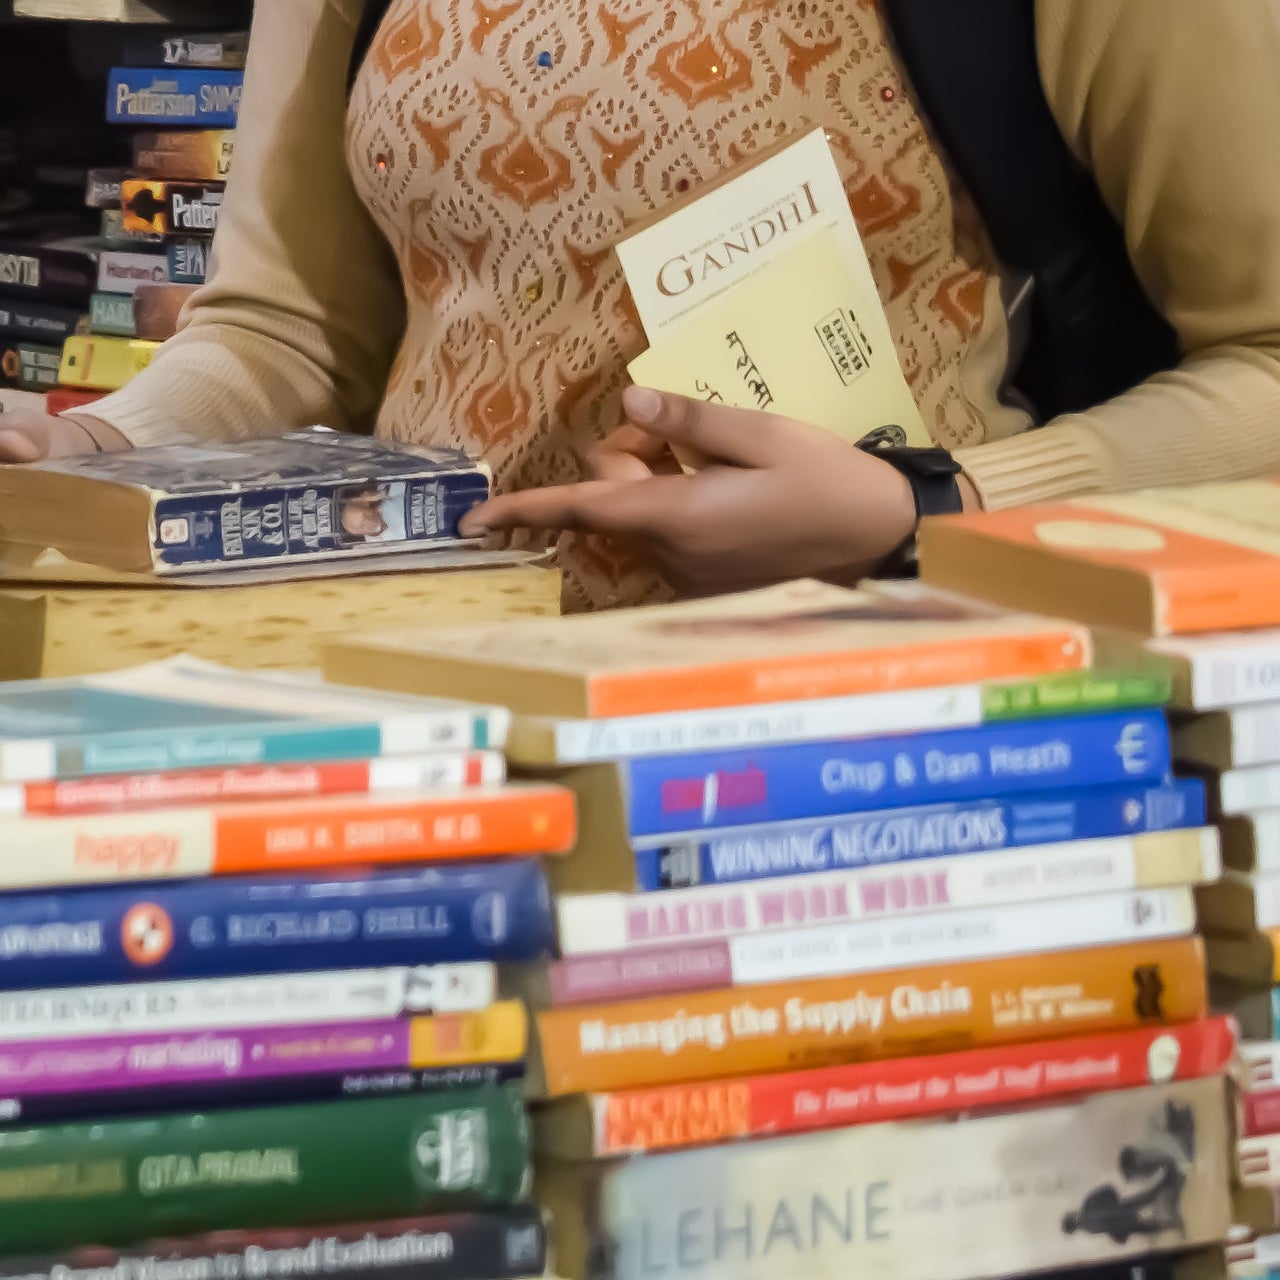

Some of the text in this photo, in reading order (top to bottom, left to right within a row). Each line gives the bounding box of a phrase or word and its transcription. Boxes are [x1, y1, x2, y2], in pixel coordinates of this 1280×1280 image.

[116, 83, 197, 116] Patterson
[656, 181, 820, 297] GANDHI
[821, 324, 853, 376] DELIVERY
[832, 318, 863, 371] EXPRESS
[221, 497, 243, 556] FATHER
[243, 508, 262, 541] SON
[820, 754, 885, 794] Chip
[925, 748, 980, 782] Dan
[990, 738, 1071, 773] Heath
[74, 832, 181, 874] happy
[708, 806, 1007, 879] WINNING NEGOTIATIONS
[227, 909, 354, 943] RICHARD
[626, 872, 951, 939] MAKING WORK WORK
[580, 981, 973, 1056] Managing the Supply Chain
[126, 1033, 244, 1073] marketing
[606, 1083, 750, 1120] RICHARD
[639, 1179, 893, 1274] LEHANE
[242, 1242, 319, 1277] Brand
[323, 1231, 455, 1272] Evaluation
